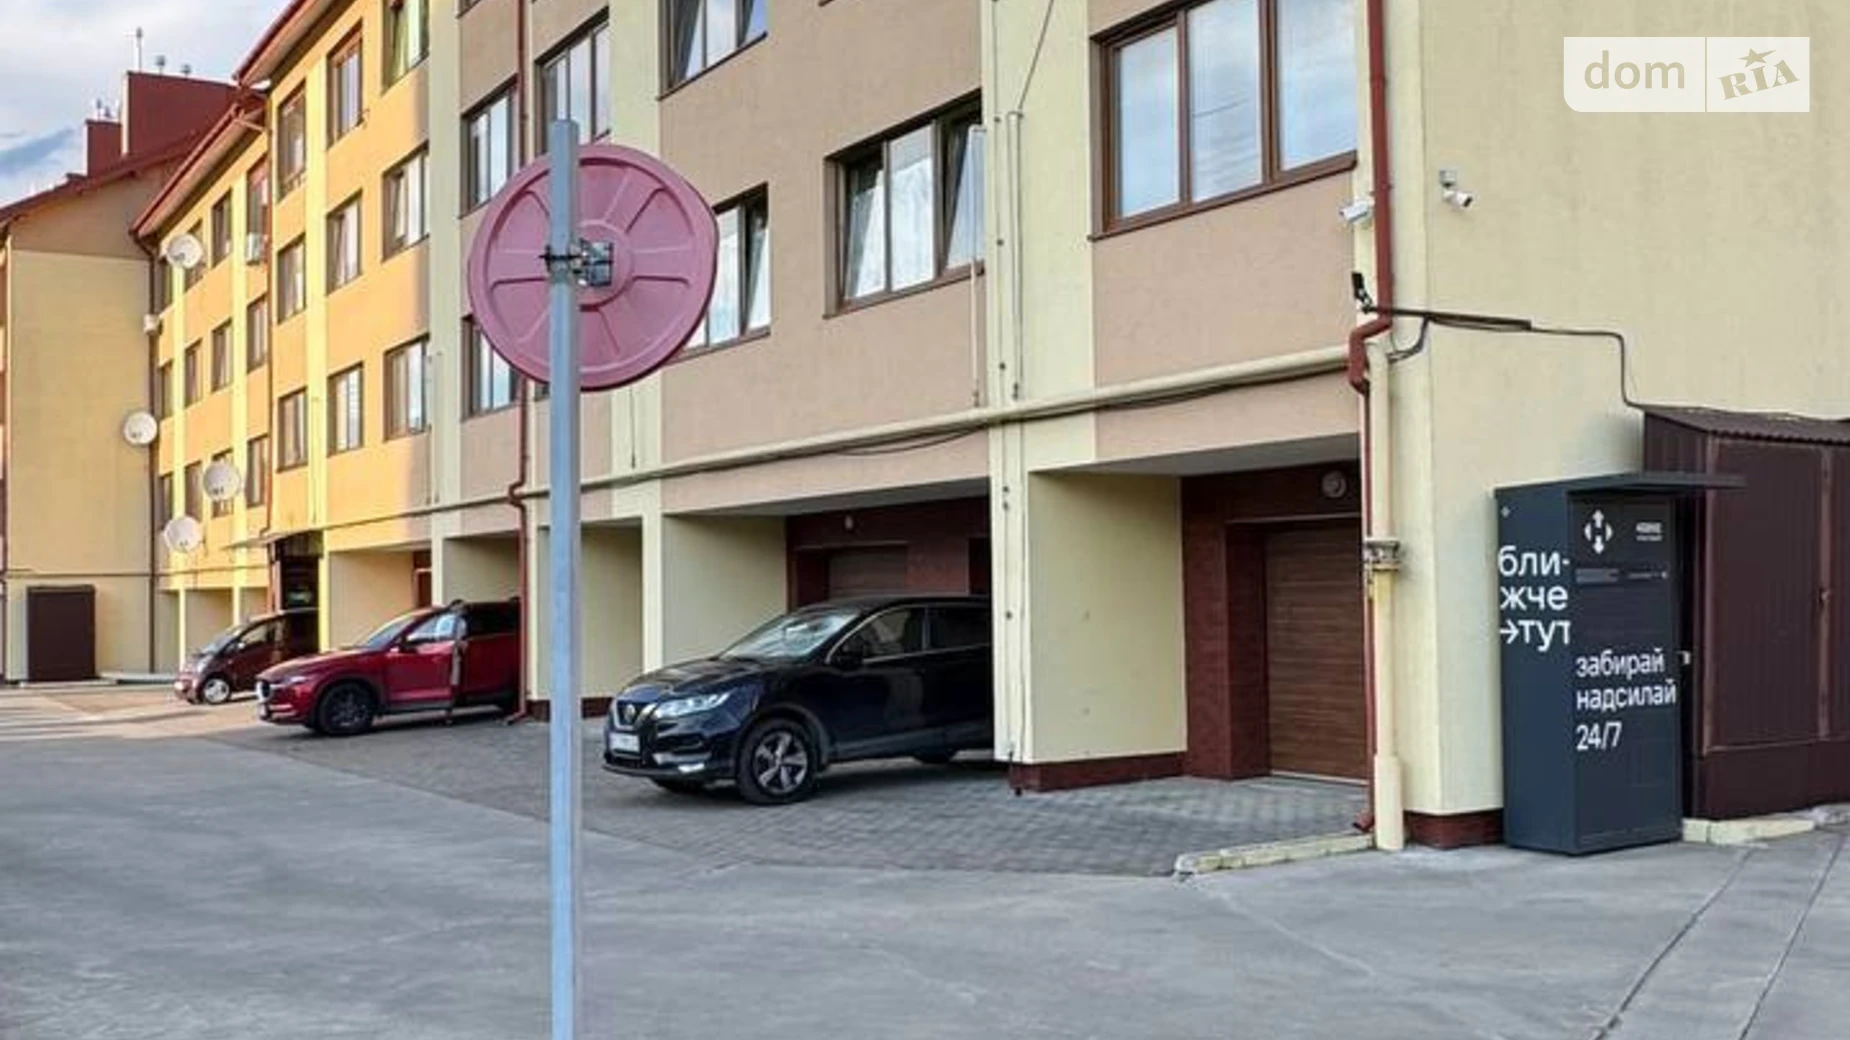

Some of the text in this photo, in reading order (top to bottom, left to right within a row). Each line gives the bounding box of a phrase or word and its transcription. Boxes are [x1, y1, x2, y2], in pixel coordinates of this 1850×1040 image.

[1500, 585, 1568, 611] жче
[1576, 648, 1664, 679] забирай
[1576, 679, 1676, 712] надсилай
[1576, 722, 1622, 751] 24/7
